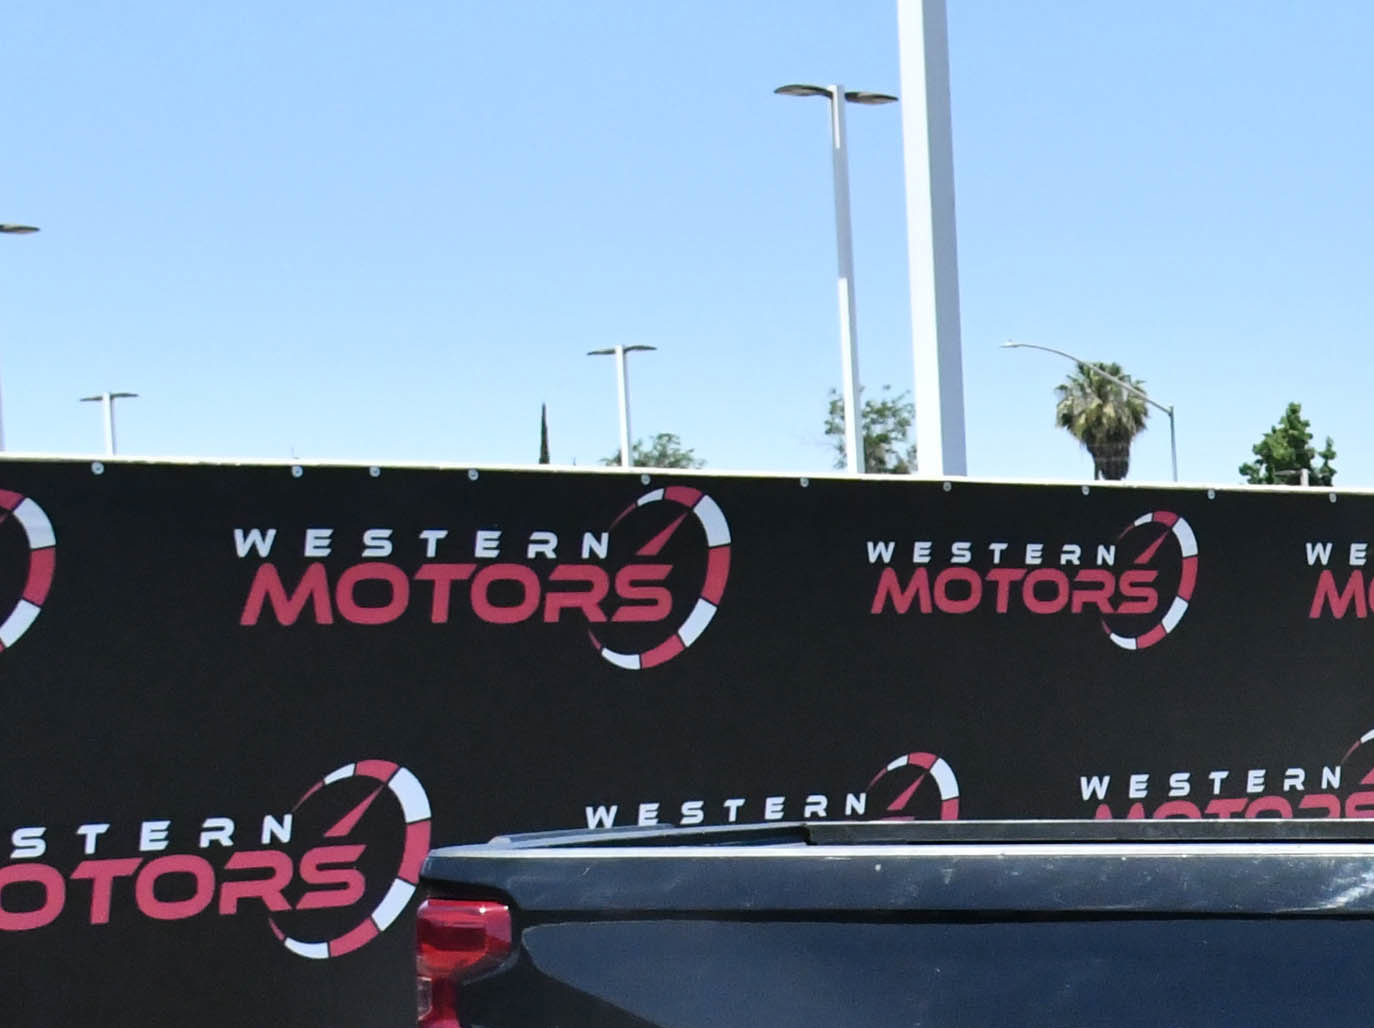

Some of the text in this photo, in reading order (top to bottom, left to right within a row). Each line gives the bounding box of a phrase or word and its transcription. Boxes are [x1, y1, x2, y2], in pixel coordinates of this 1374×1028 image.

[234, 528, 609, 559] WESTERN
[867, 541, 1116, 566] WESTERN
[241, 563, 673, 625] MOTORS
[871, 567, 1158, 614] MOTORS
[1080, 765, 1341, 801] WESTERN
[585, 792, 866, 829] WESTERN
[10, 814, 293, 859] STERN
[0, 845, 367, 931] OTORS
